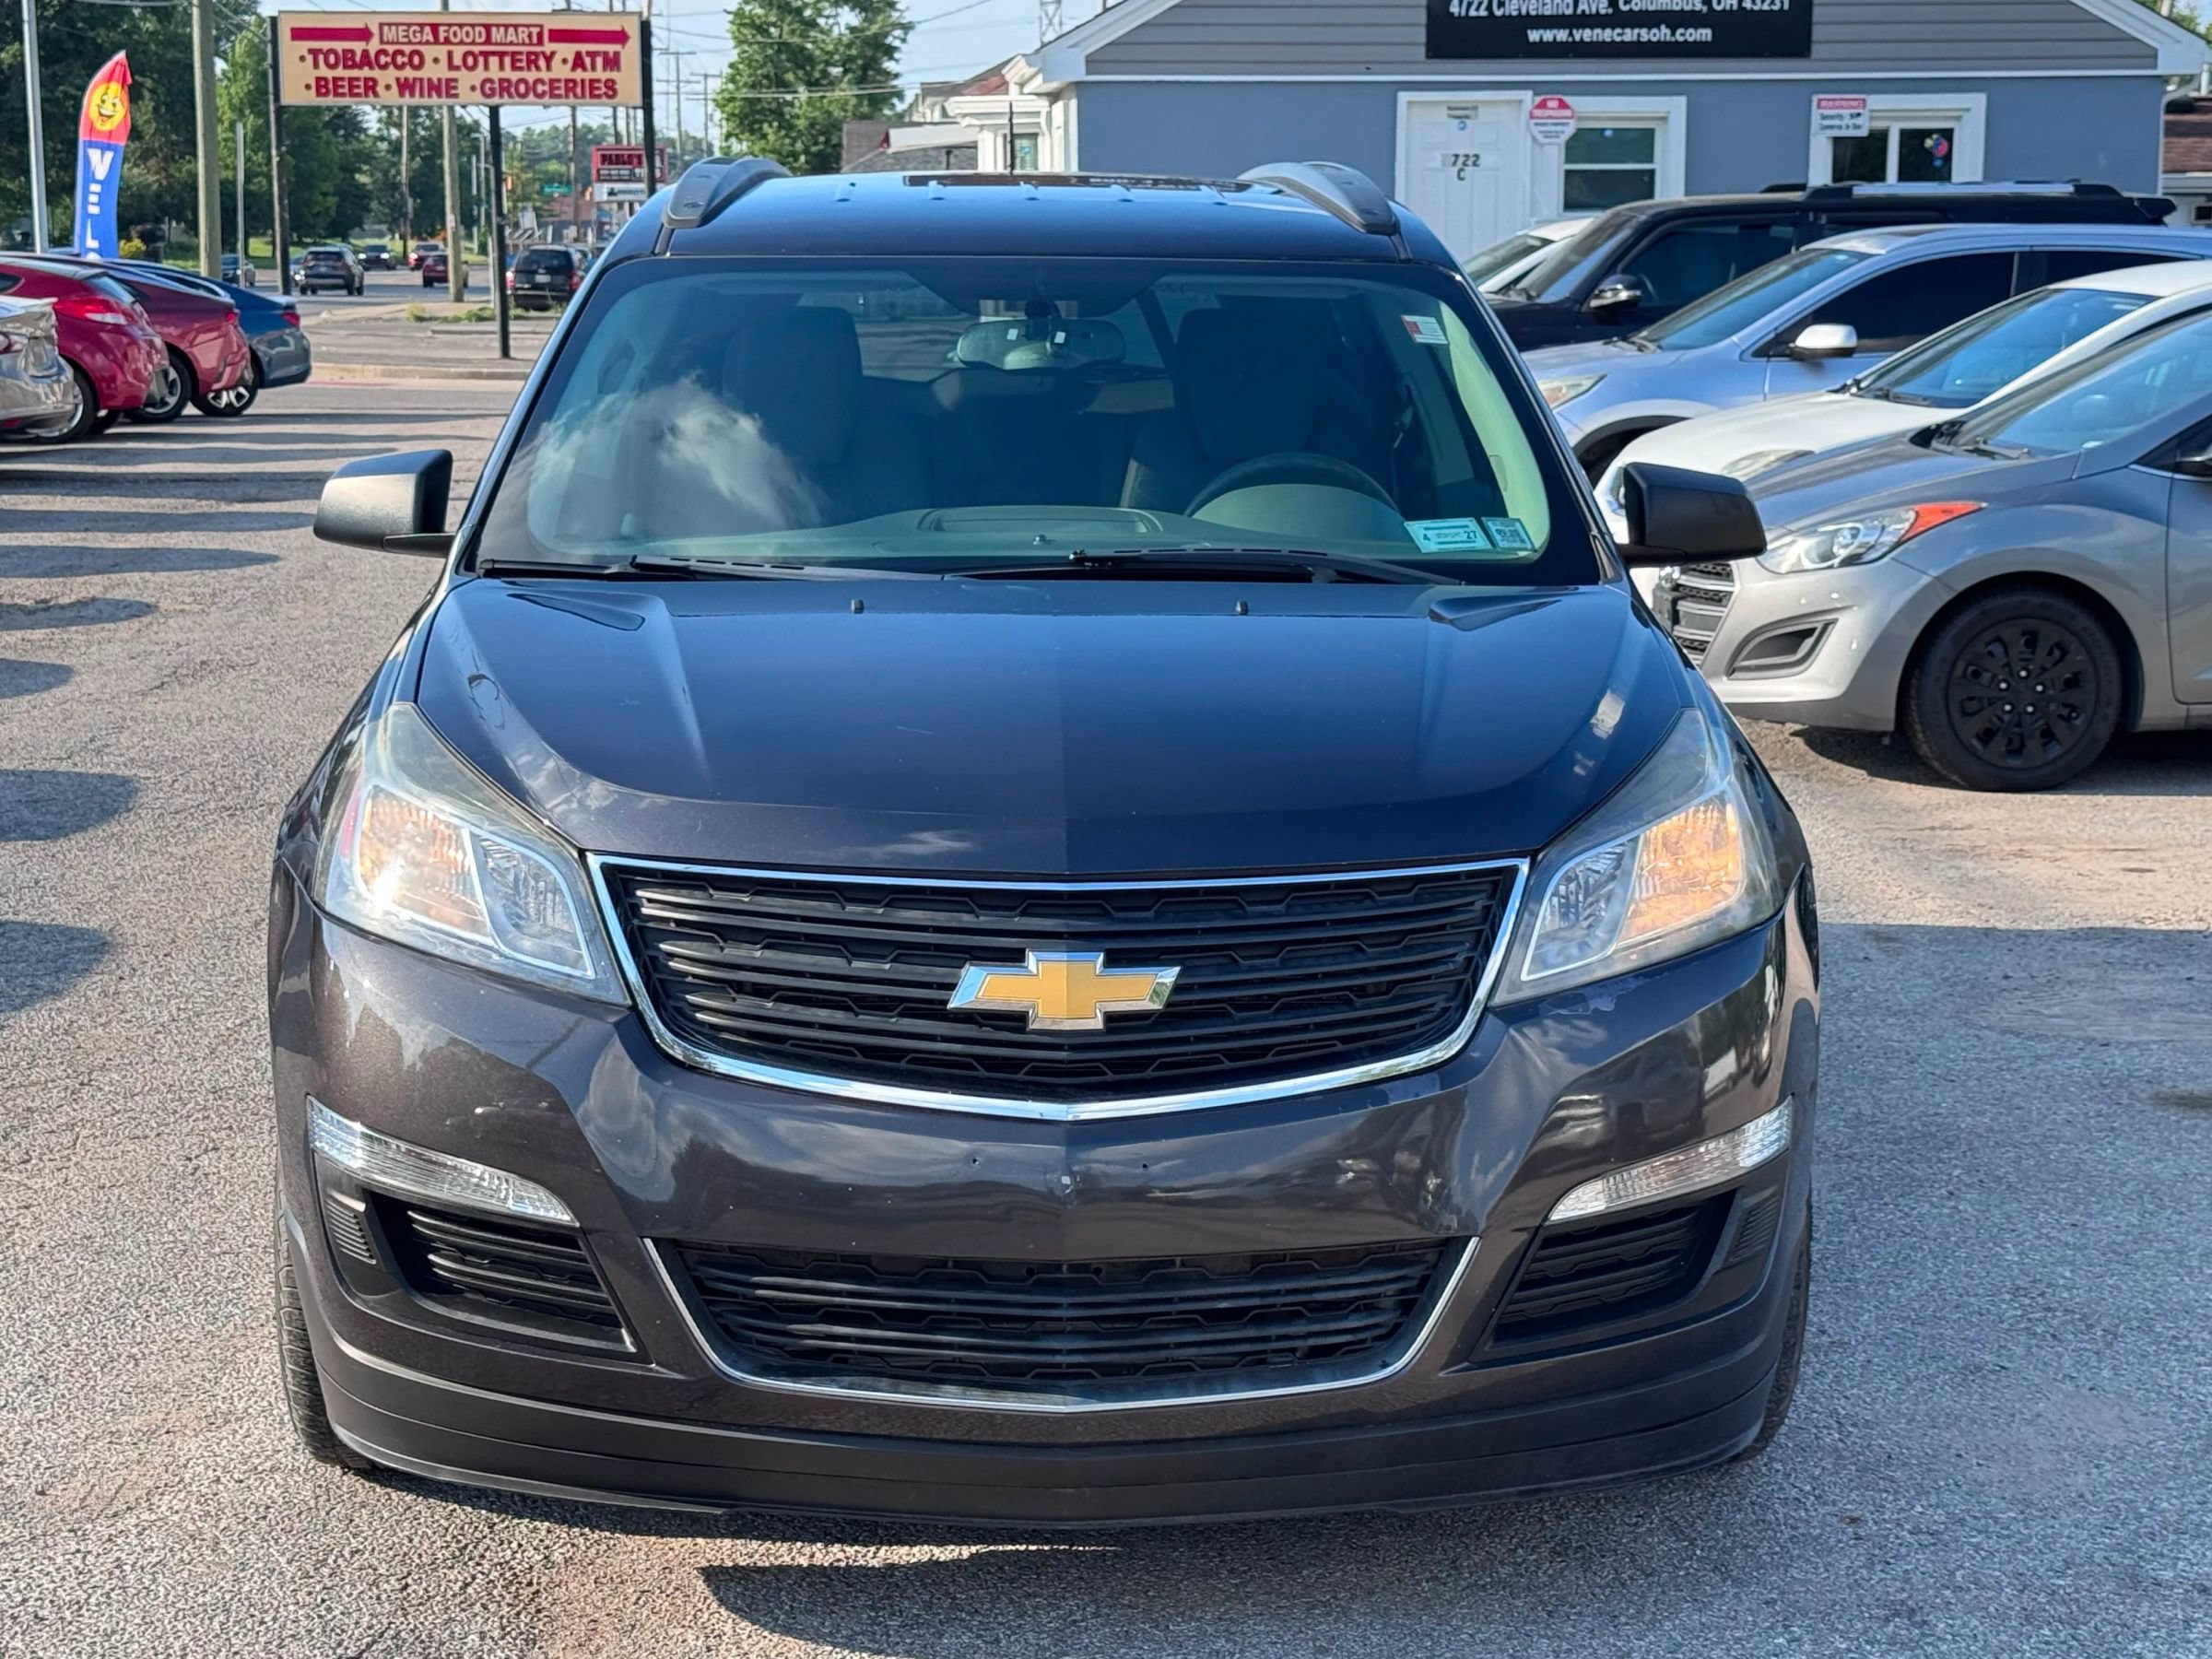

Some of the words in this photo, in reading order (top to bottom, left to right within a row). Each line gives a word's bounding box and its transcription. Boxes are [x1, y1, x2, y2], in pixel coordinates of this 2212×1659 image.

[1449, 0, 1488, 17] 4722
[1492, 0, 1574, 17] Cleveland
[1576, 0, 1614, 15] Ave.
[1618, 0, 1708, 13] Columbus,
[1712, 0, 1739, 11] OH
[382, 24, 435, 44] MEGA
[439, 25, 488, 44] FOOD
[490, 26, 541, 45] MART
[1526, 24, 1712, 42] www.venecarsoh.com
[308, 48, 425, 71] TOBACCO
[446, 50, 558, 73] LOTTERY
[571, 51, 622, 73] ATM
[315, 76, 380, 99] BEER
[394, 77, 460, 99] WINE
[479, 77, 619, 100] GROCERIES
[1451, 153, 1480, 168] 722
[1456, 168, 1466, 182] C
